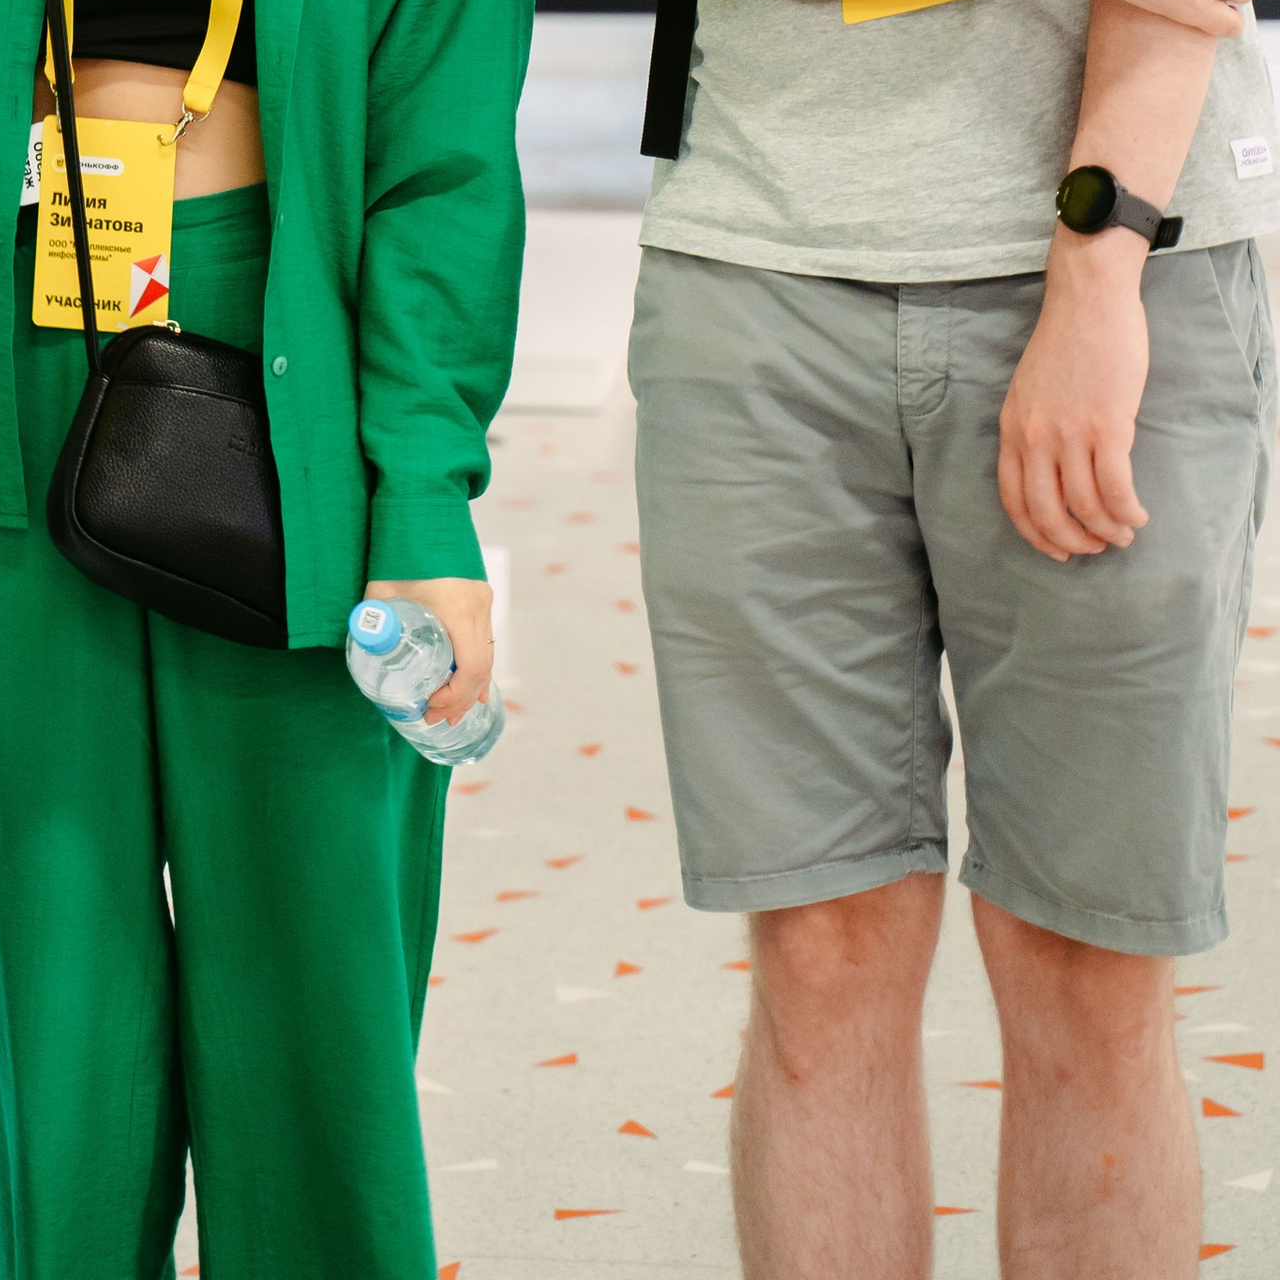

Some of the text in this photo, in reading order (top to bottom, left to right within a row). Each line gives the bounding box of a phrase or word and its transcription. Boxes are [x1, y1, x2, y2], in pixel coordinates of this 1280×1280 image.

[24, 152, 35, 190] таж
[51, 191, 107, 210] Лиия
[49, 212, 144, 233] Зинатова
[48, 239, 68, 248] ООО
[45, 294, 122, 312] УЧАСНИК
